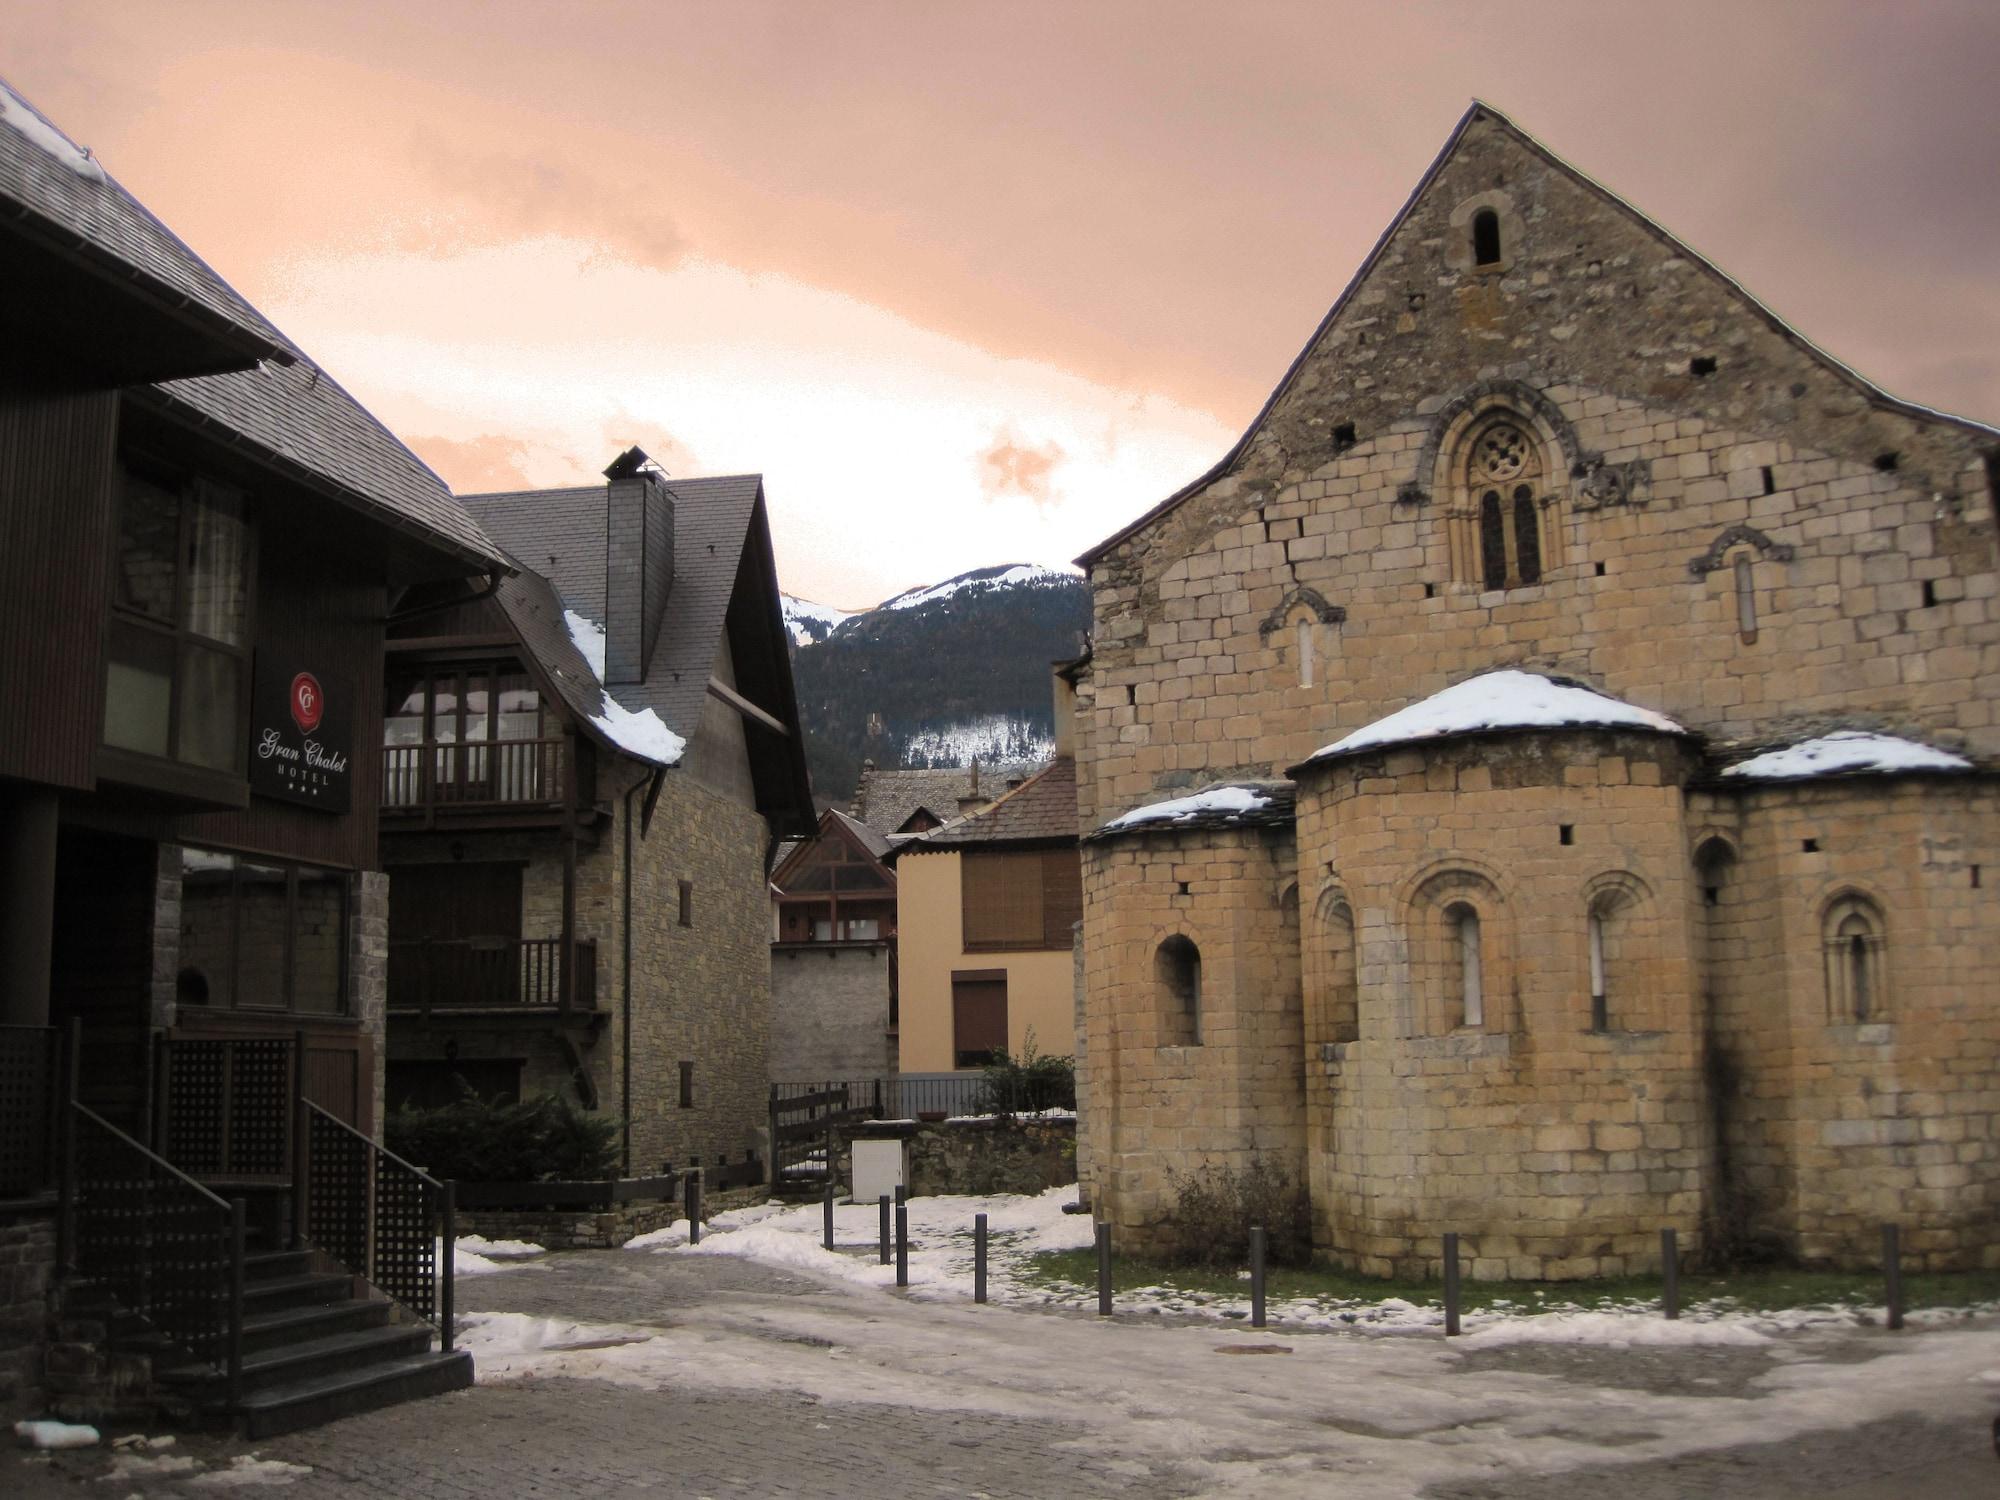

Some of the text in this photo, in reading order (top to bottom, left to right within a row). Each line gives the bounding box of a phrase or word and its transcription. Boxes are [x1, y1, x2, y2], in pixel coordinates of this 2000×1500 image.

[258, 728, 347, 773] Gran Chalet
[278, 764, 329, 786] HOTEL
